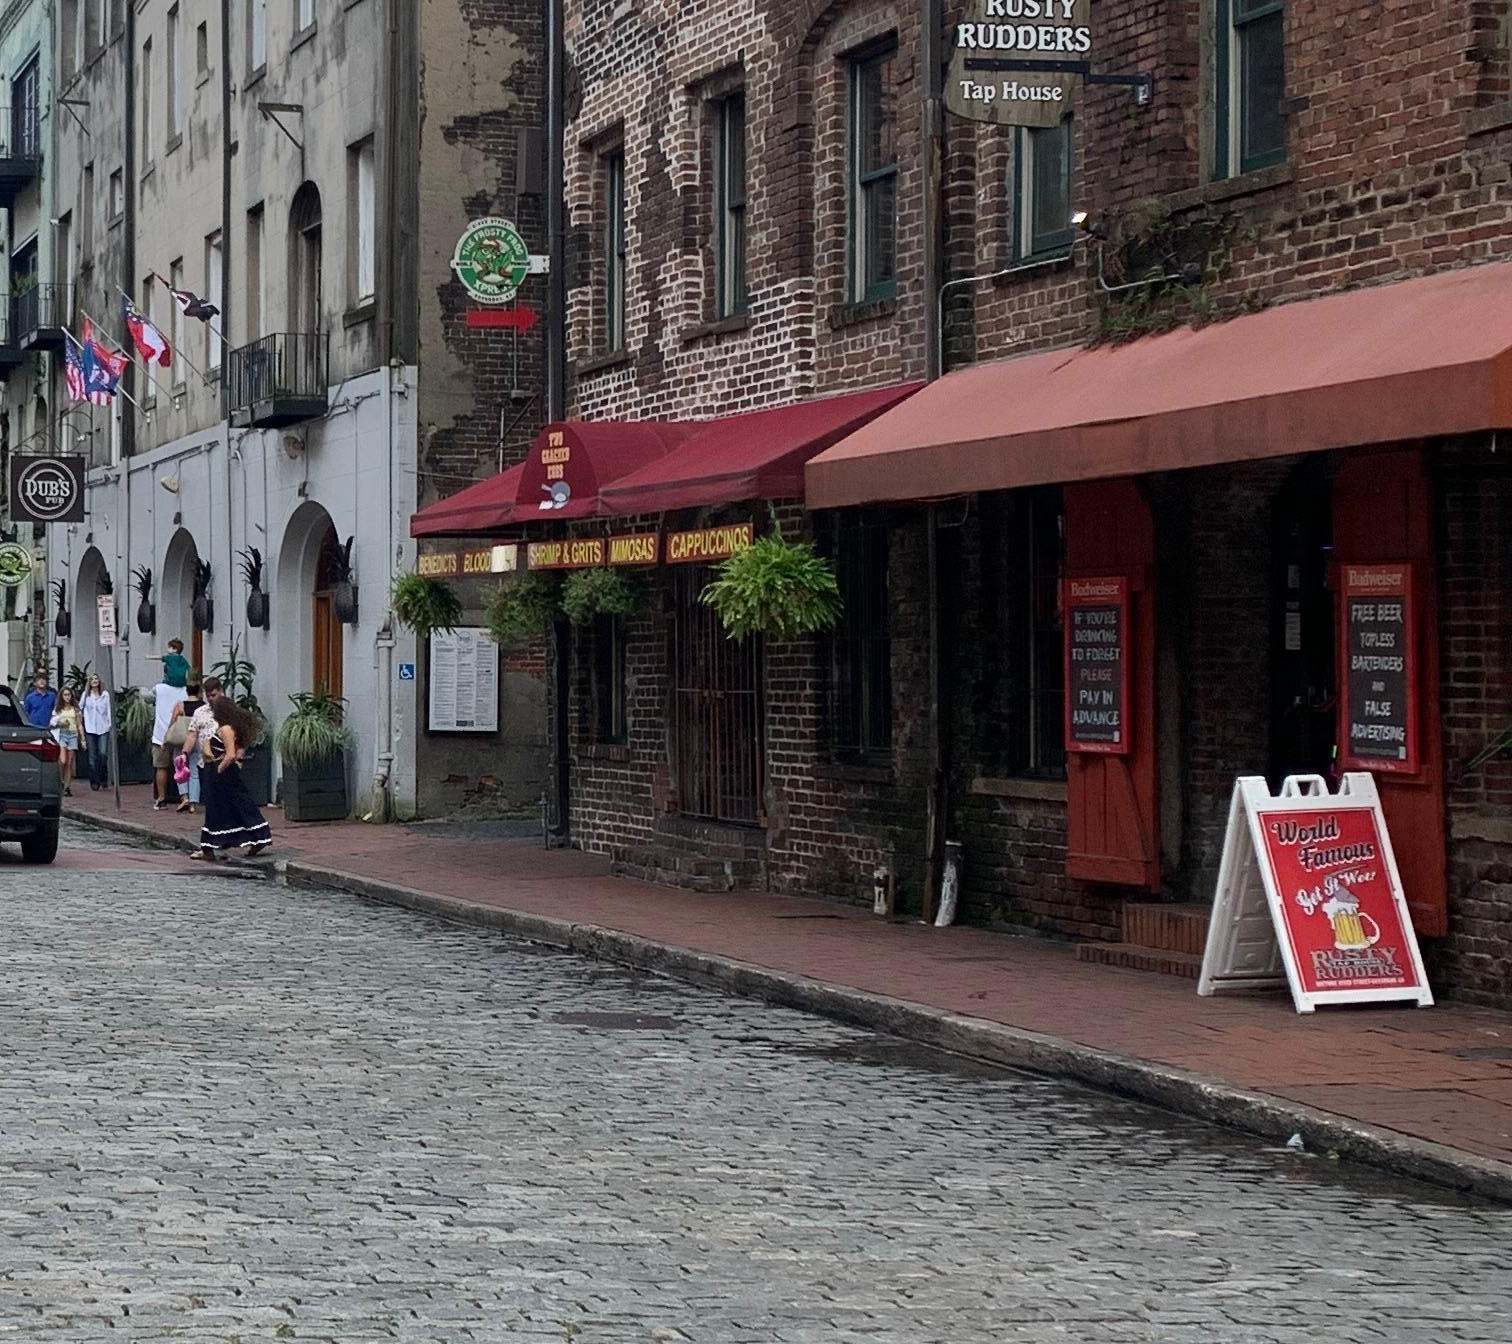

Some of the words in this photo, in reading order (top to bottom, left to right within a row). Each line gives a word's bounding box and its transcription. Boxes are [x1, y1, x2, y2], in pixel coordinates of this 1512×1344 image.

[957, 23, 1091, 52] RUDDERS
[959, 80, 996, 104] Tap
[1002, 81, 1063, 102] House
[474, 228, 506, 241] FROSTY
[507, 235, 524, 255] FROG
[25, 478, 70, 497] DUB'S
[611, 537, 655, 563] MIMOSAS
[671, 526, 750, 559] CAPPUCCINOS
[530, 542, 561, 566] SHRIMP
[562, 543, 570, 564] &
[571, 540, 602, 564] GRITS
[418, 553, 457, 576] BENEDICTS
[1348, 569, 1402, 586] Budweiser
[1071, 581, 1120, 597] Budweiser
[1351, 604, 1376, 623] FREE
[1377, 604, 1403, 623] BEER
[1075, 629, 1117, 643] DRINKING
[1360, 632, 1395, 648] TOPLESS
[1072, 647, 1084, 661] TO
[1086, 647, 1120, 661] FORGET
[1351, 655, 1404, 672] BARTENDERS
[1080, 668, 1113, 681] PLEASE
[1079, 690, 1100, 704] PAY
[1102, 690, 1113, 705] IN
[1073, 710, 1120, 726] ADVANCE
[1365, 701, 1392, 716] FALSE
[1351, 723, 1405, 742] ADVERTISING
[1271, 816, 1341, 845] World
[1298, 842, 1376, 873] Famous
[1310, 946, 1397, 967] RUSTY
[1315, 964, 1404, 979] RUDDERS
